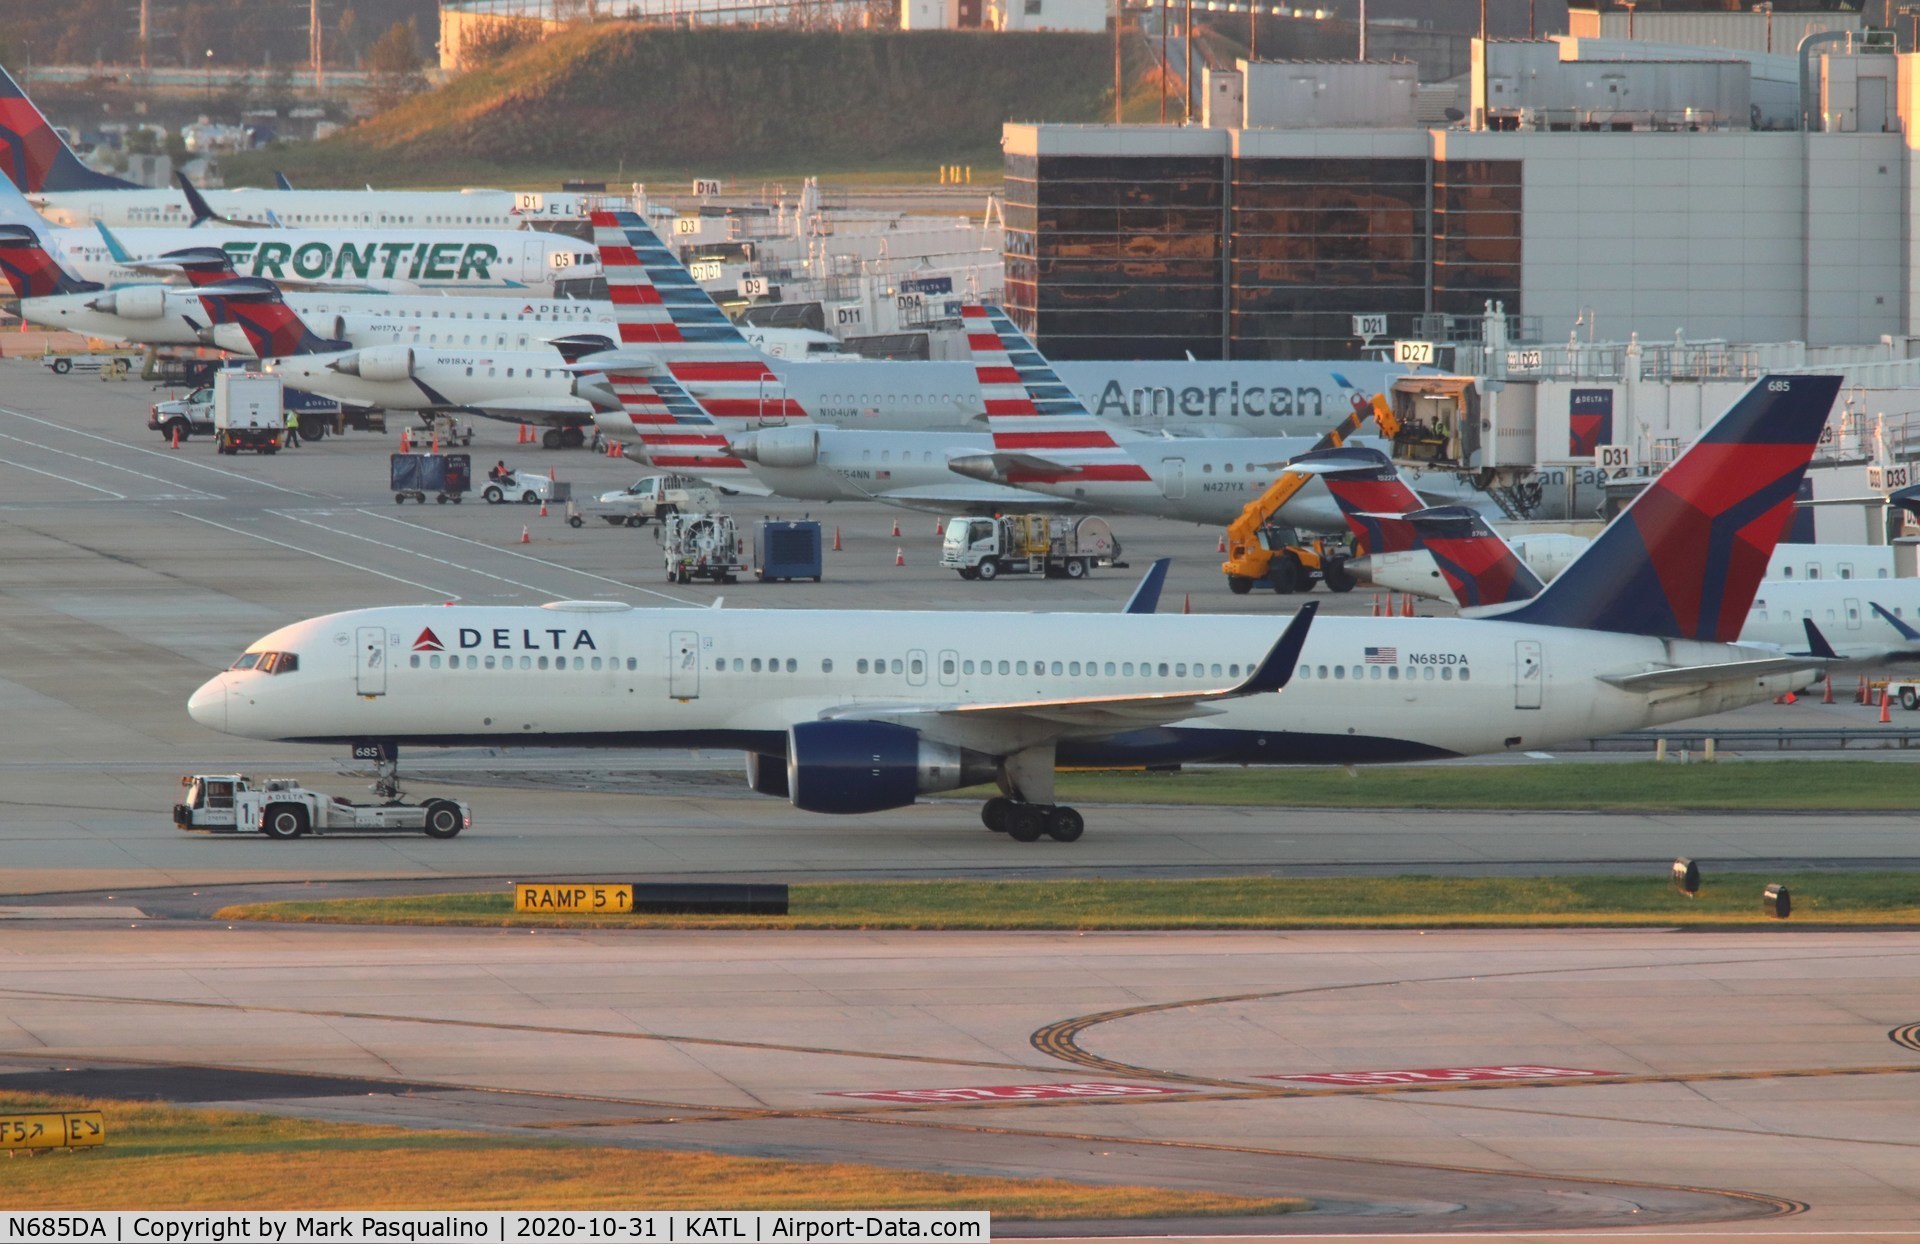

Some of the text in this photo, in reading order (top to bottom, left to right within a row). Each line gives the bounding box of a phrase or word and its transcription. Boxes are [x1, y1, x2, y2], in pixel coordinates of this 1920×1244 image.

[698, 182, 719, 195] D1A
[523, 195, 537, 208] D1
[681, 220, 695, 233] D3
[221, 242, 498, 280] FRONTIER
[555, 254, 569, 267] D5
[692, 266, 704, 280] D7
[708, 264, 719, 278] D7
[745, 281, 760, 294] D9
[540, 305, 592, 314] DELTA
[898, 296, 921, 310] D9A
[838, 310, 861, 324] D11
[370, 324, 404, 333] N917XJ
[1363, 319, 1382, 334] D21
[1402, 344, 1429, 362] D27
[437, 357, 474, 366] N918XJ
[1522, 352, 1540, 368] D23
[1768, 381, 1790, 392] 685
[1096, 379, 1322, 417] American
[819, 407, 859, 418] N104UW
[1603, 448, 1630, 466] D31
[1887, 468, 1907, 488] D33
[1203, 482, 1244, 493] N427YX
[459, 628, 597, 650] DELTA
[1409, 653, 1469, 665] N685DA
[356, 747, 378, 758] 685
[275, 793, 304, 801] DELTA
[525, 889, 607, 908] RAMP 5
[0, 1119, 83, 1143] F5 E
